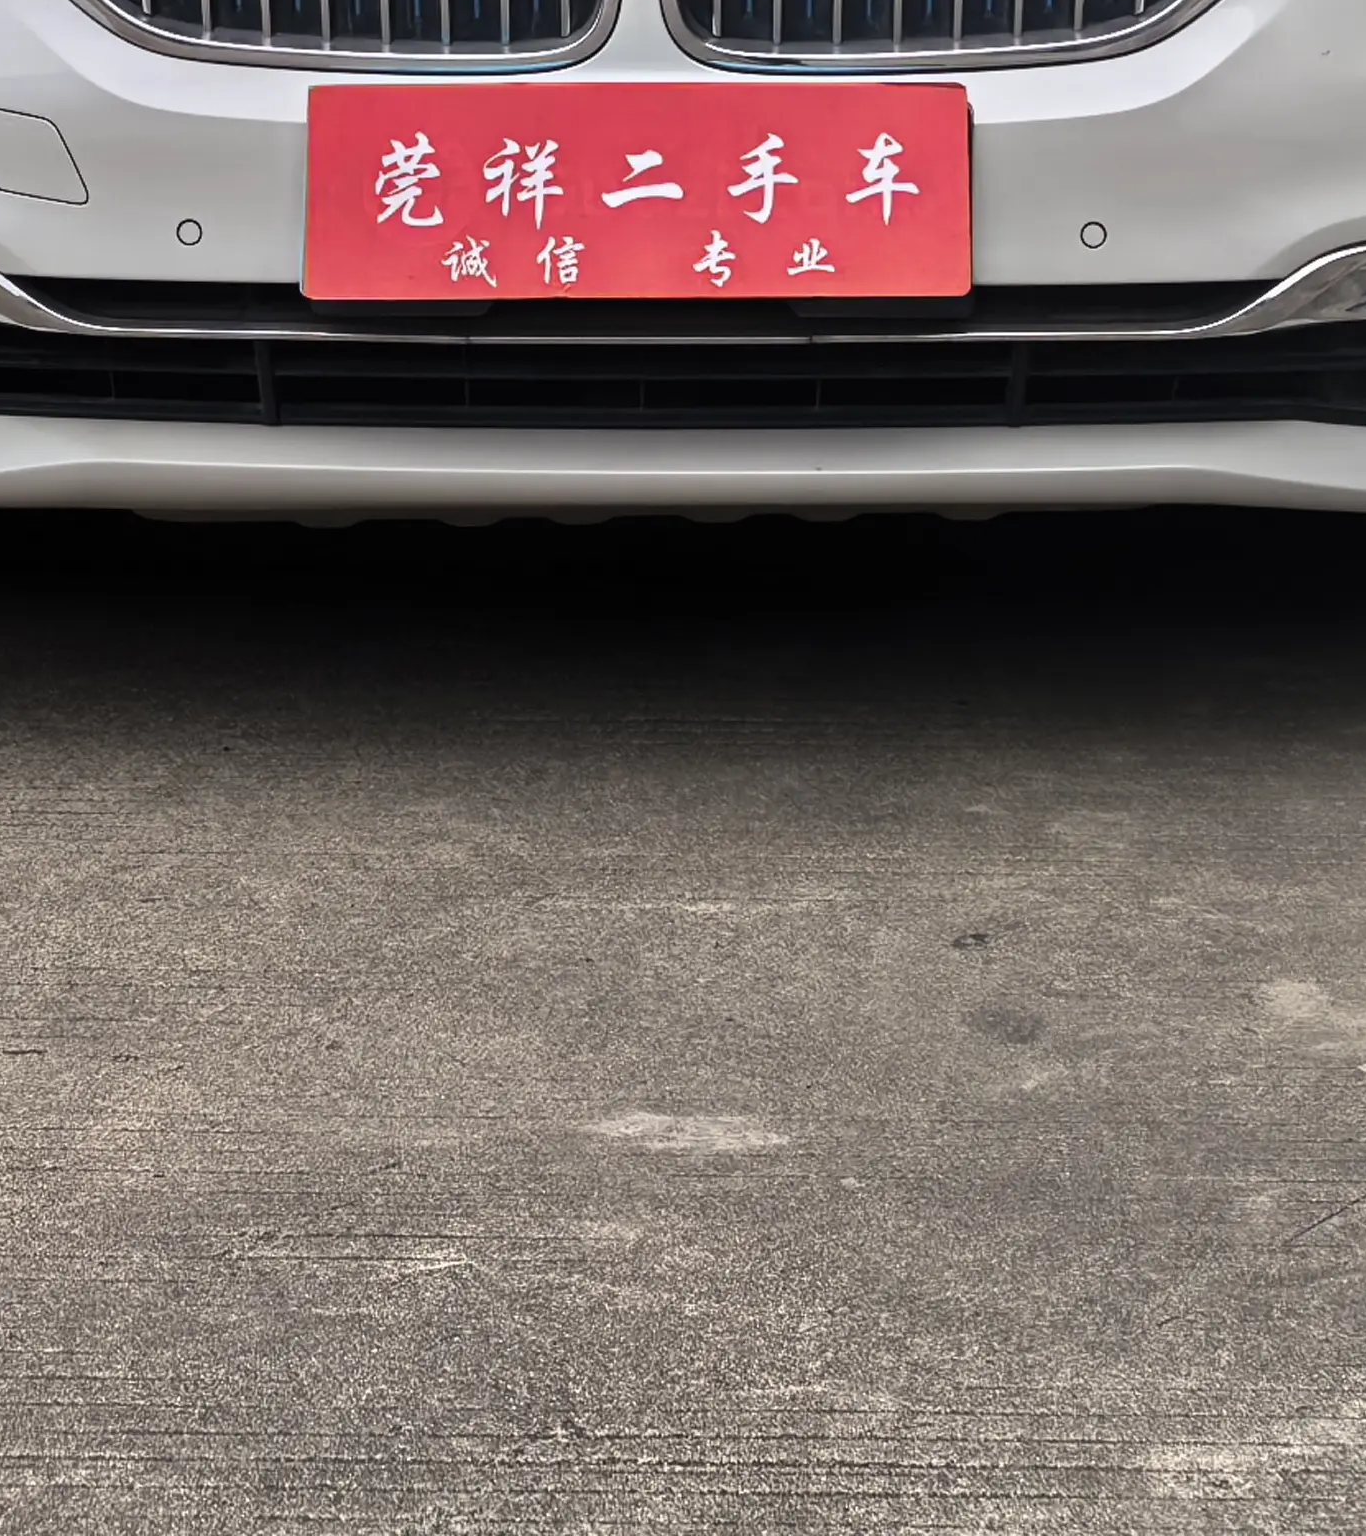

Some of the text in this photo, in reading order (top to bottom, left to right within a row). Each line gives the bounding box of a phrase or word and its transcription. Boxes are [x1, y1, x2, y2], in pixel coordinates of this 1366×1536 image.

[375, 131, 920, 230] 莞祥二手车
[441, 230, 836, 287] 诚信 专业
